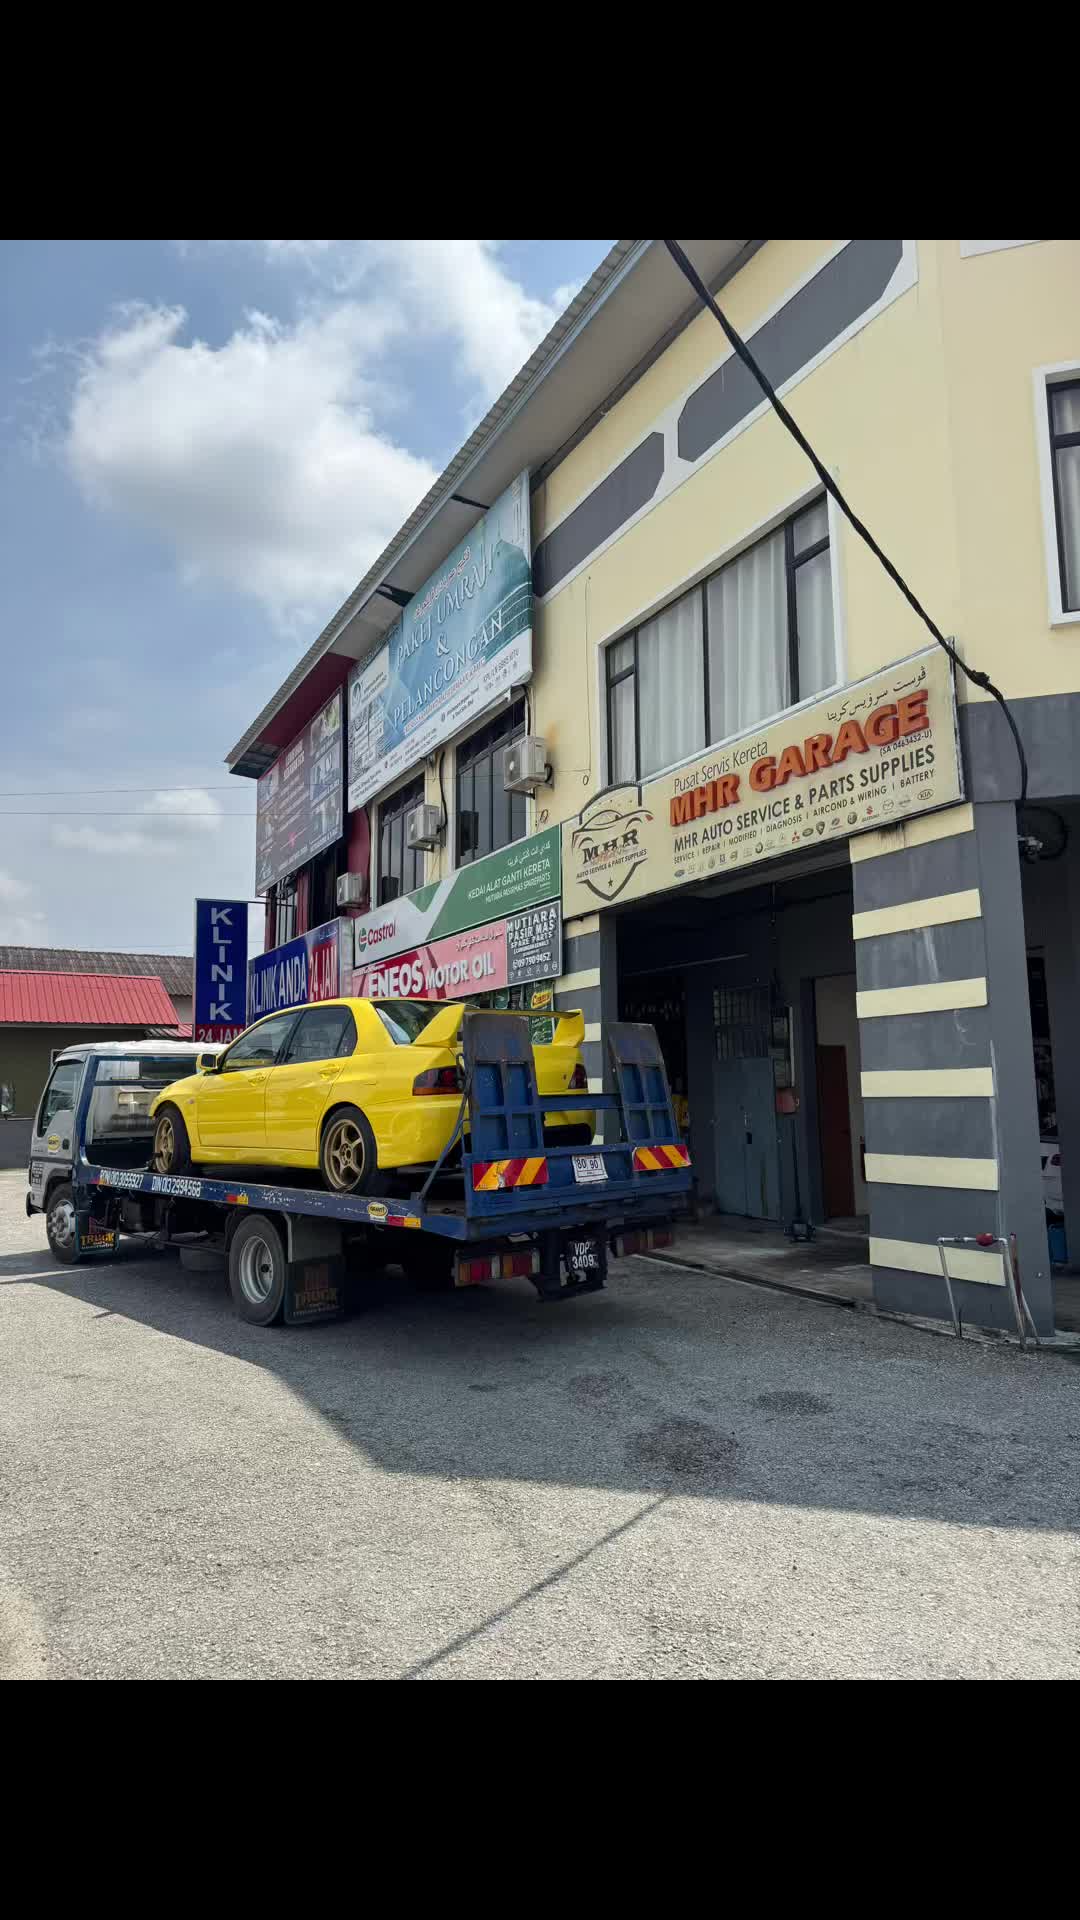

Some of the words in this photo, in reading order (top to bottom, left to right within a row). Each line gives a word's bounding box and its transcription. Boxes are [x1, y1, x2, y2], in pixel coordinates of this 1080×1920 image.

[436, 632, 450, 657] &
[394, 609, 503, 727] PELANCONGAN
[670, 773, 740, 827] MHR
[749, 689, 930, 792] GARAGE
[674, 771, 699, 794] Pusat
[702, 757, 730, 782] Servis
[733, 741, 768, 768] Kereta
[673, 851, 695, 864] SERVICE
[702, 842, 720, 855] REPAIR
[728, 830, 757, 846] MODIFIED
[766, 813, 803, 833] DIAGNOSIS
[813, 799, 848, 817] AIRCOND
[858, 785, 887, 803] WIRING
[900, 768, 935, 788] BATTERY
[674, 832, 698, 853] MHR
[702, 819, 733, 843] AUTO
[736, 797, 790, 831] SERVICE
[794, 794, 804, 810] &
[809, 773, 855, 805] PARTS
[860, 744, 935, 788] SUPPLIES
[582, 828, 640, 864] MHR
[468, 884, 486, 899] KEDAI
[485, 878, 501, 893] ALAT
[501, 869, 522, 886] GANTI
[523, 858, 551, 878] KERETA
[367, 918, 396, 945] Castrol
[506, 907, 557, 933] MUTIARA
[508, 926, 534, 942] PASIR
[535, 920, 555, 935] MAS
[510, 938, 530, 949] SPARE
[531, 931, 553, 943] PARTS
[209, 907, 233, 1021] KLINIK
[250, 964, 278, 1015] KLINIK
[278, 952, 308, 1007] ANDA
[308, 951, 319, 1002] 24
[319, 944, 337, 1000] JAM
[368, 959, 424, 997] ENEOS
[426, 961, 470, 990] MOTOR
[471, 951, 497, 979] OIL
[199, 1028, 213, 1043] 24
